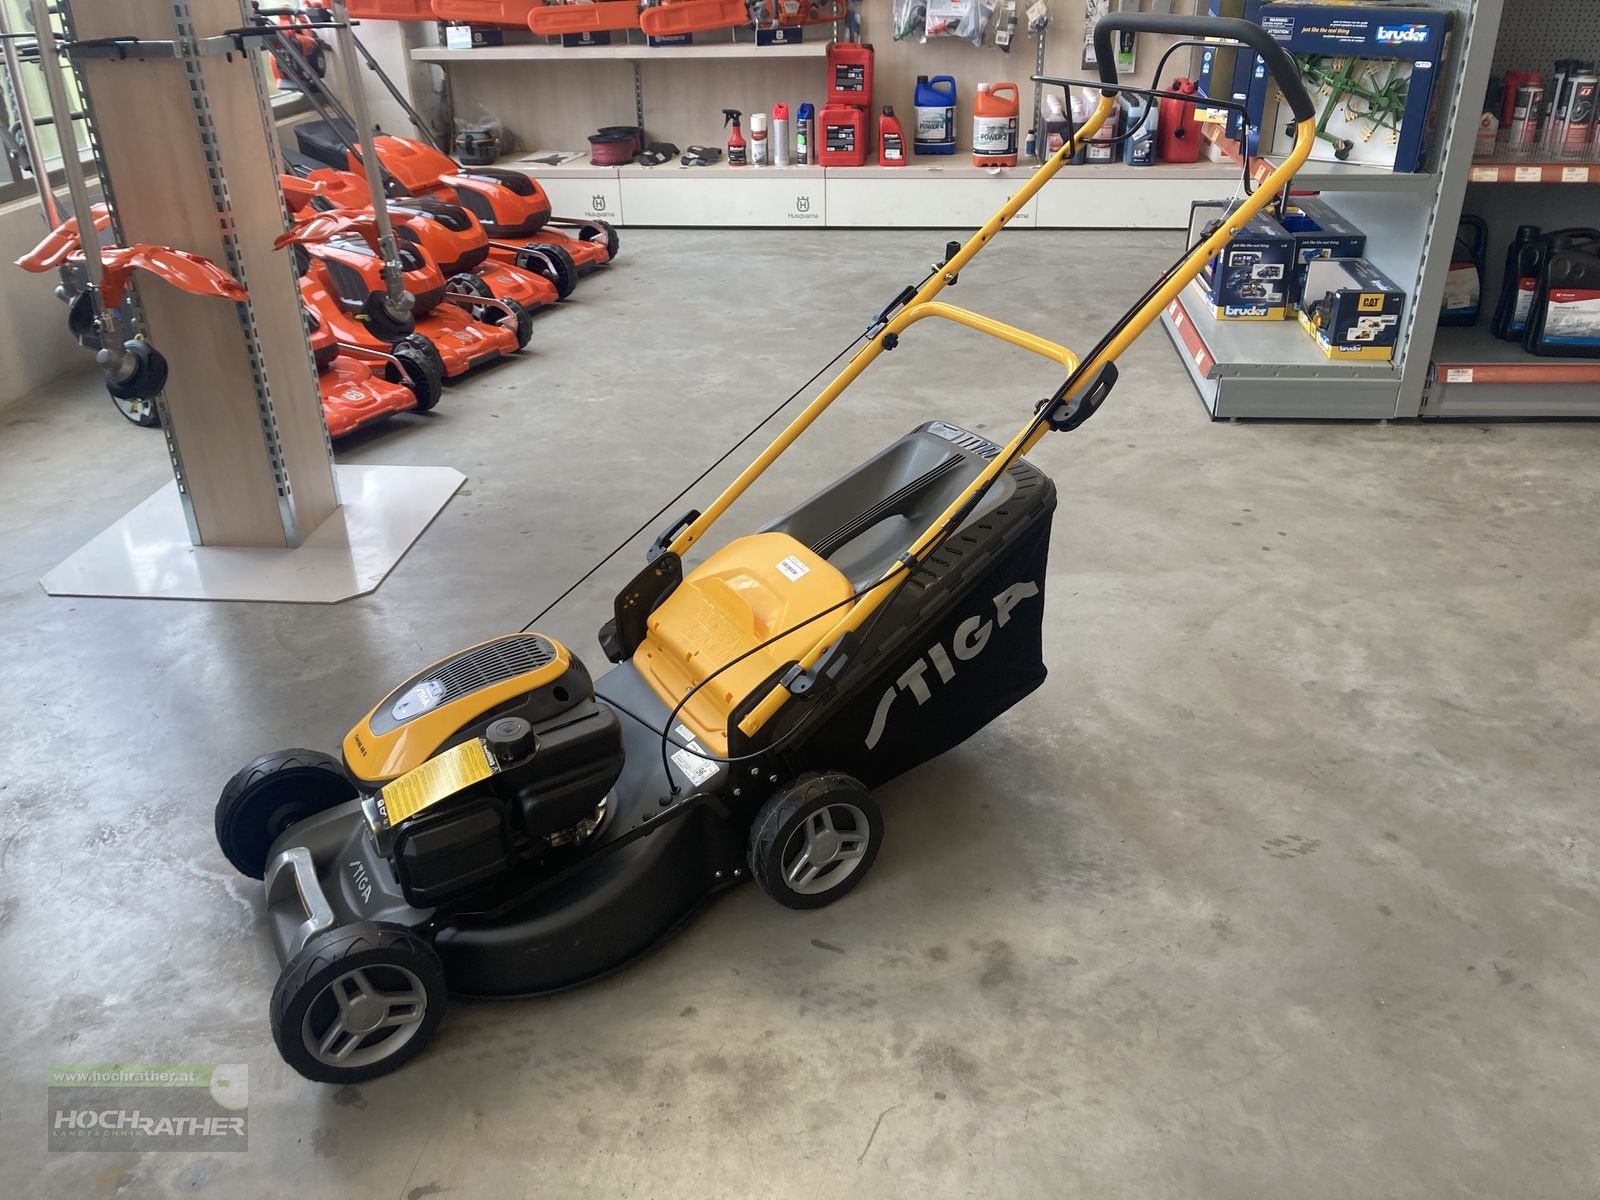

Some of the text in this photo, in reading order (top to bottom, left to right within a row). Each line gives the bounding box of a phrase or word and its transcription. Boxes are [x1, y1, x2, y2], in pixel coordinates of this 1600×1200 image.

[1377, 26, 1427, 41] bruder
[585, 210, 615, 218] Husqvarna
[788, 212, 818, 220] Husqvarna
[1363, 298, 1379, 306] CAT
[1225, 305, 1267, 316] bruder
[864, 580, 1040, 750] STIGA
[349, 861, 371, 904] STIGA
